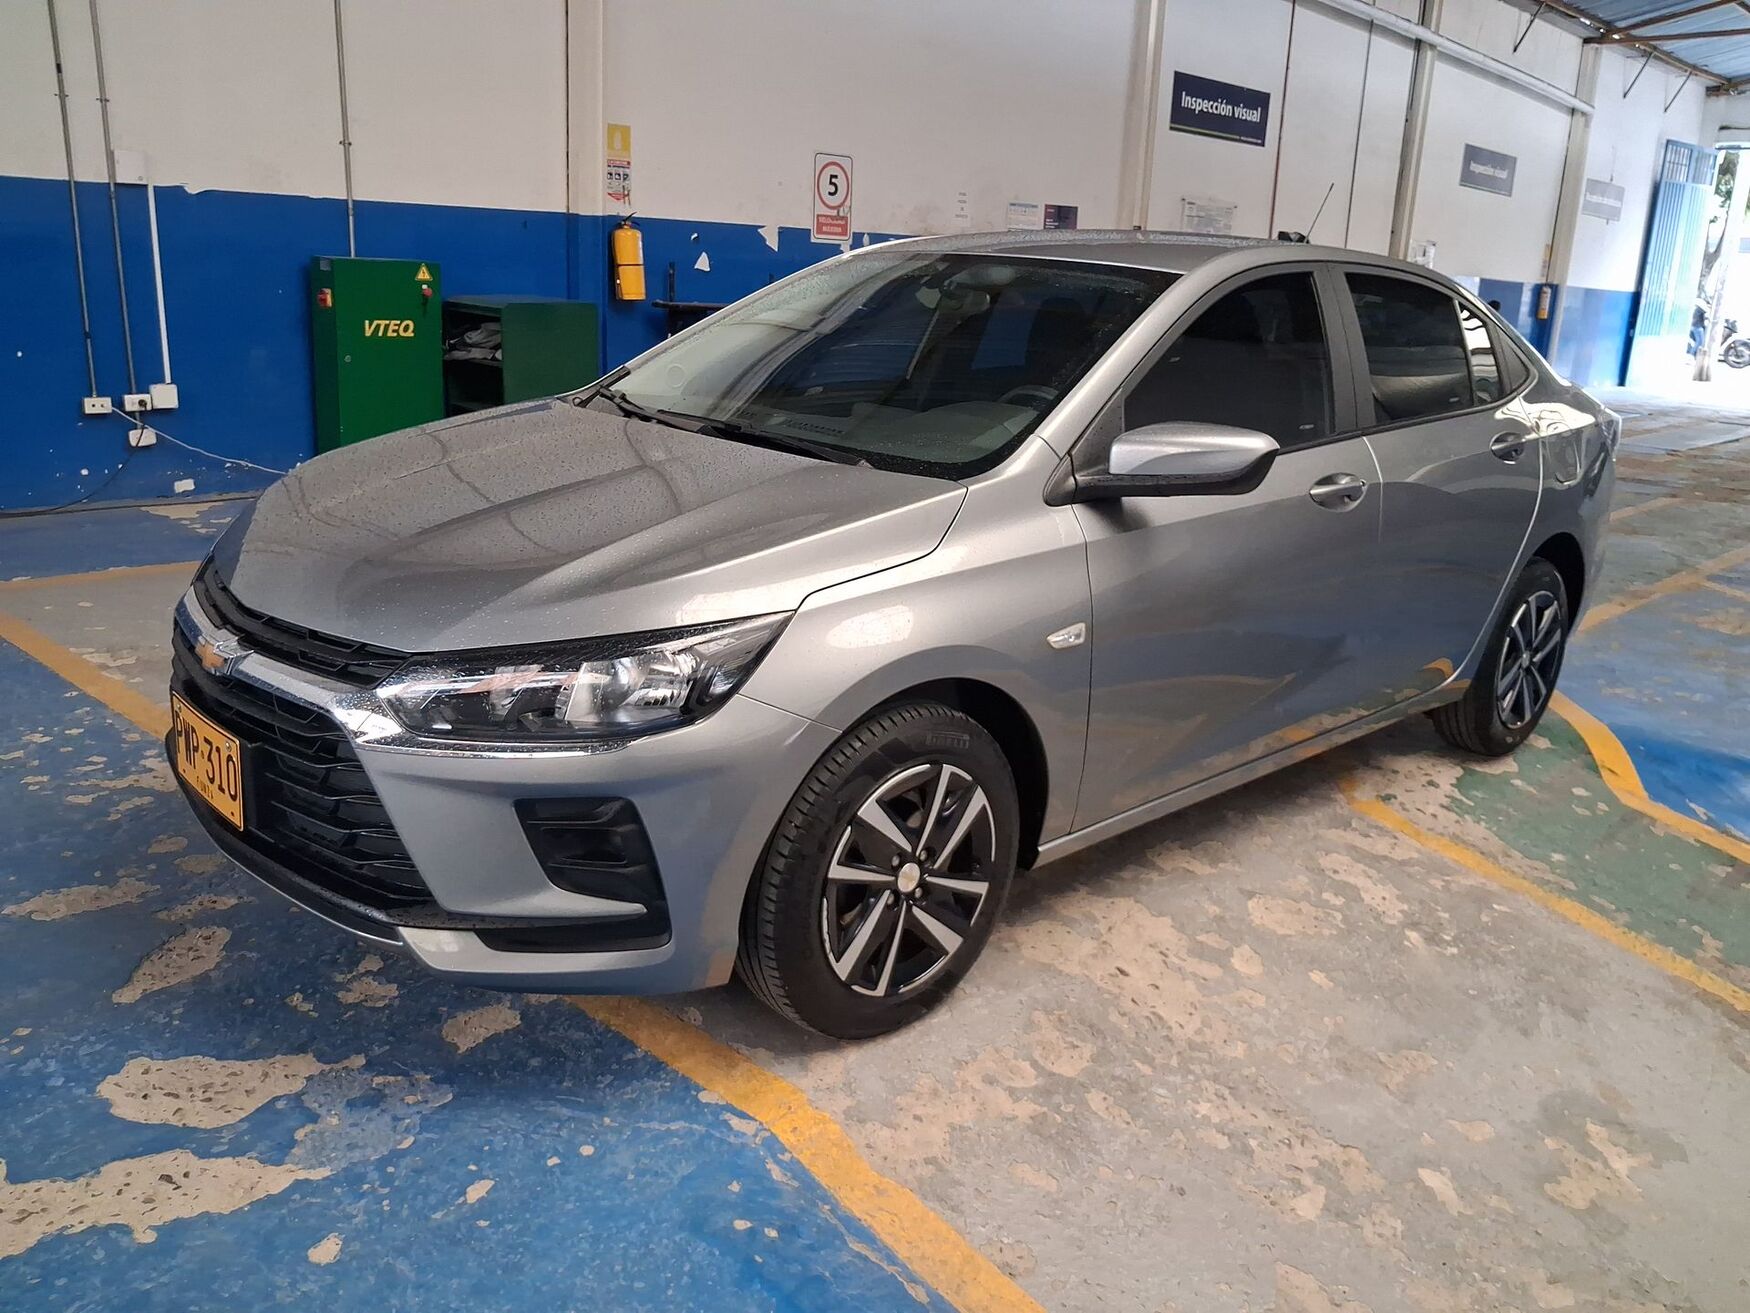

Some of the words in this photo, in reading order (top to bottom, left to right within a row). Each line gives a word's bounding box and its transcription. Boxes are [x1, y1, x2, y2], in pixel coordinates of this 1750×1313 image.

[1181, 91, 1232, 117] Inspección
[1234, 103, 1261, 123] visual
[828, 173, 839, 197] 5
[364, 320, 415, 337] VTEQ
